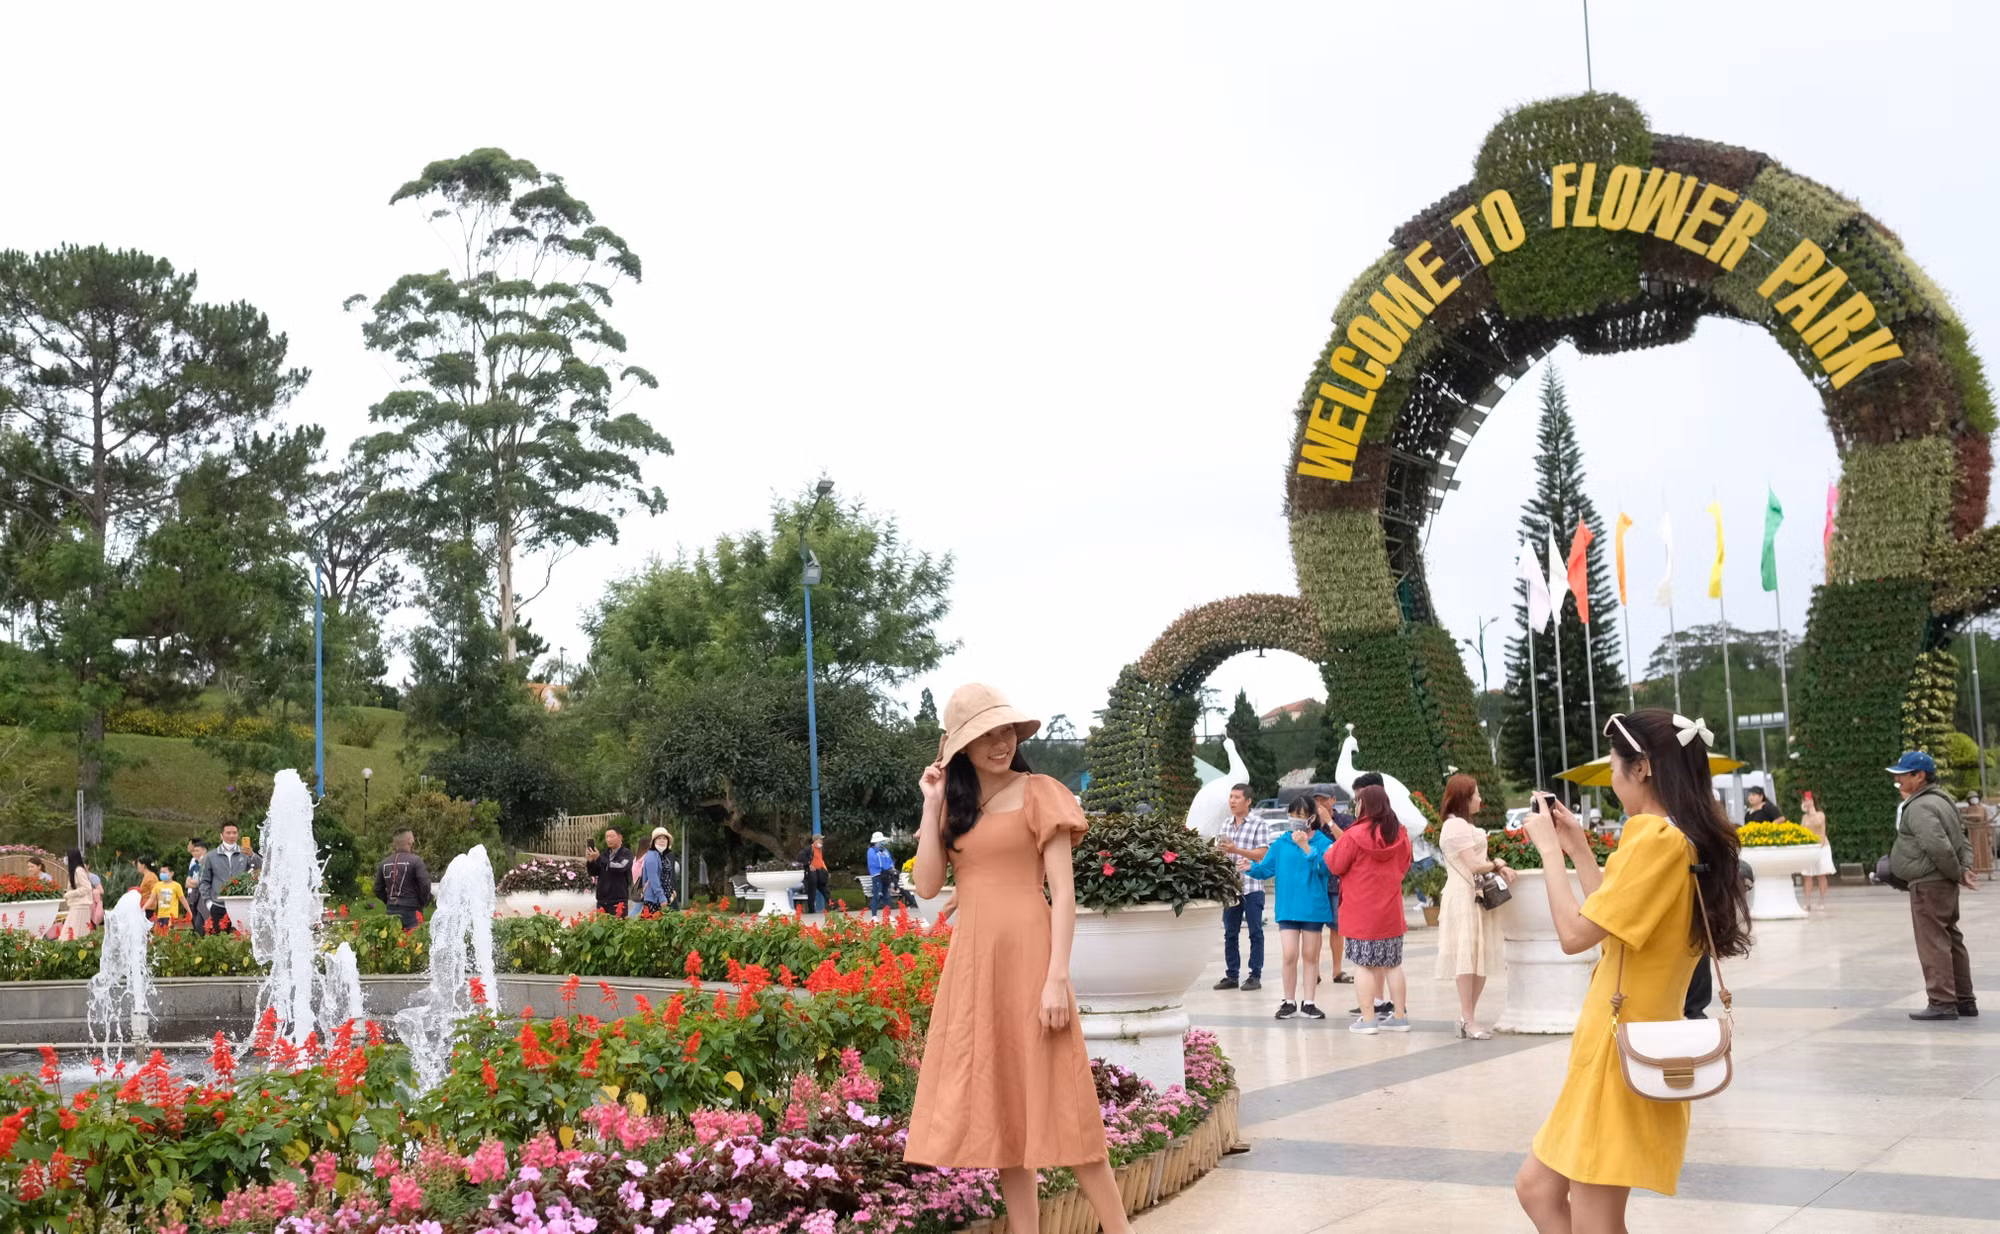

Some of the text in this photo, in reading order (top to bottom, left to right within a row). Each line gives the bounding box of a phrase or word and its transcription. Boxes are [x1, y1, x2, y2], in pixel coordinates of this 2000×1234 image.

[1297, 162, 1904, 482] WELCOME TO FLOWER PARK
